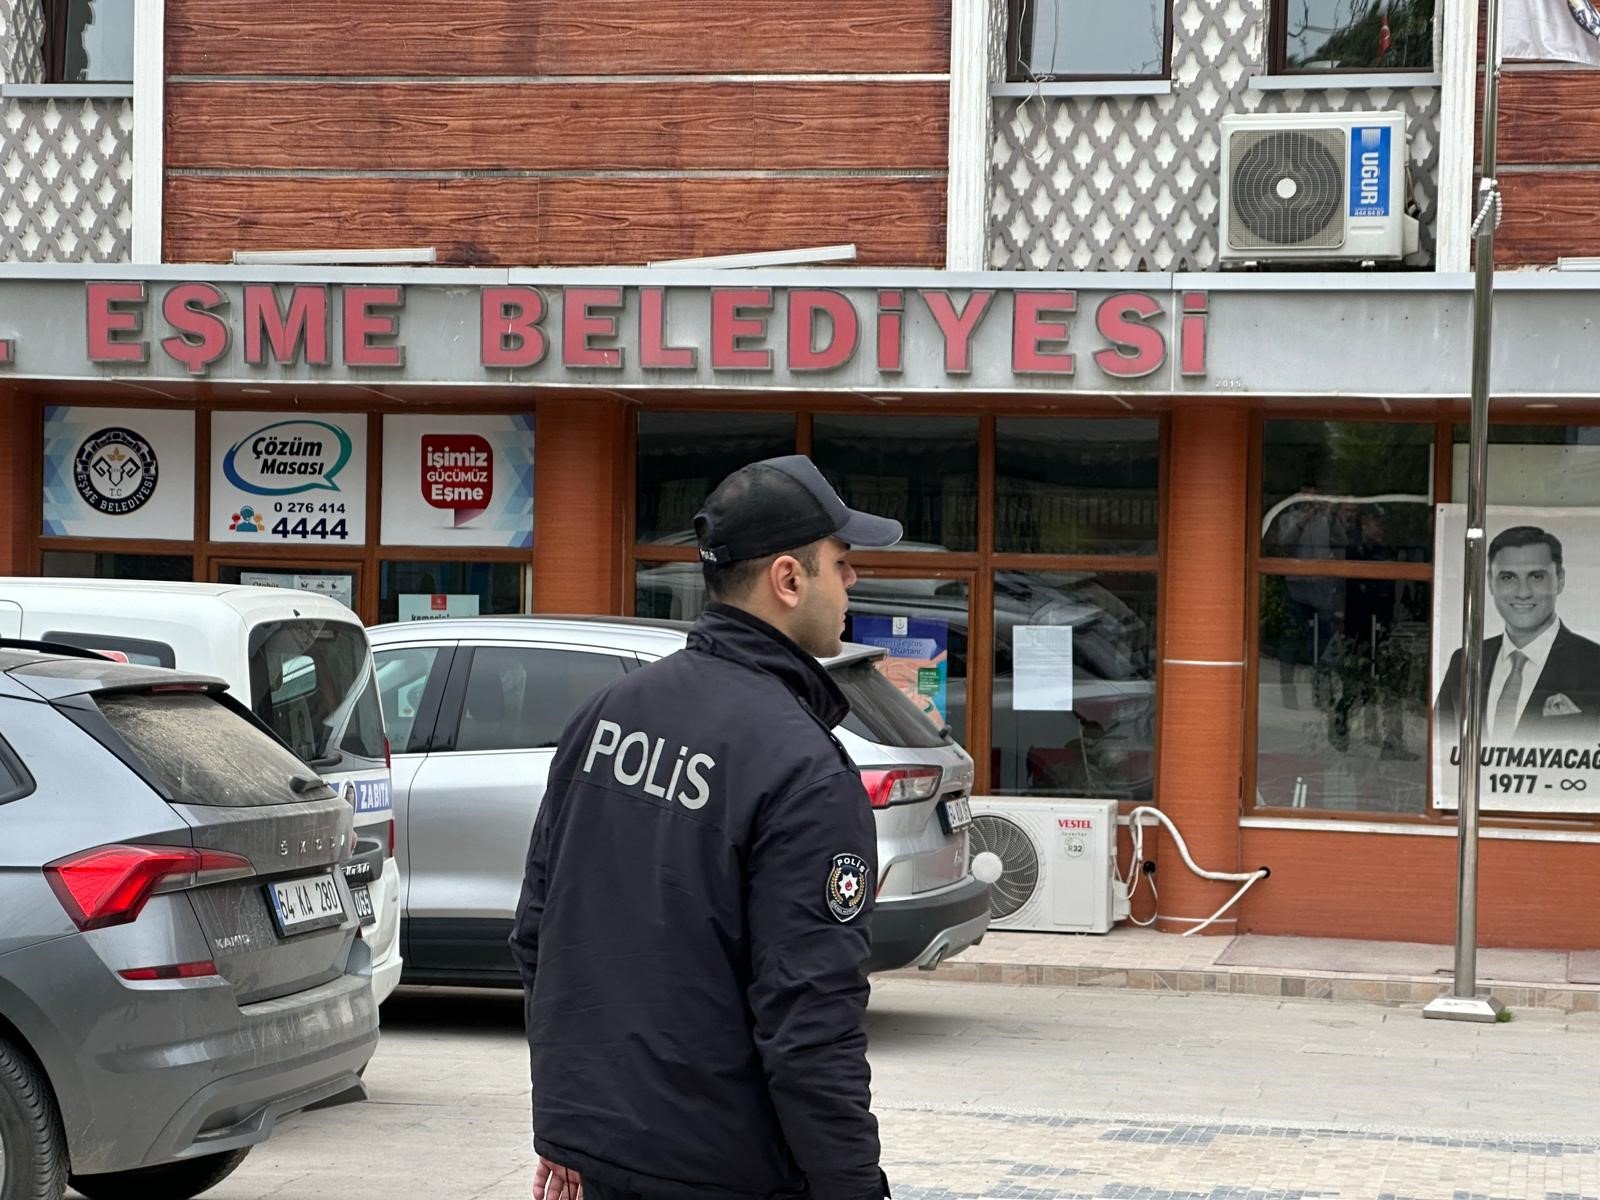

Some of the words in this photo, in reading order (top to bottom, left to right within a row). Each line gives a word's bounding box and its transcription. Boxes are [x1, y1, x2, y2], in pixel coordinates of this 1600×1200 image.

[85, 281, 403, 375] EŞME
[252, 437, 323, 459] Çözüm
[260, 459, 324, 475] Masası
[427, 468, 488, 482] GÜCÜMÜZ
[431, 484, 484, 501] Eşme
[274, 502, 282, 512] 0
[287, 503, 314, 513] 276
[318, 503, 345, 513] 414
[271, 517, 348, 539] 4444
[1489, 773, 1538, 794] 1977
[1058, 818, 1093, 829] VESTEL
[278, 889, 295, 919] 64
[295, 884, 314, 916] KA
[314, 880, 338, 911] 280
